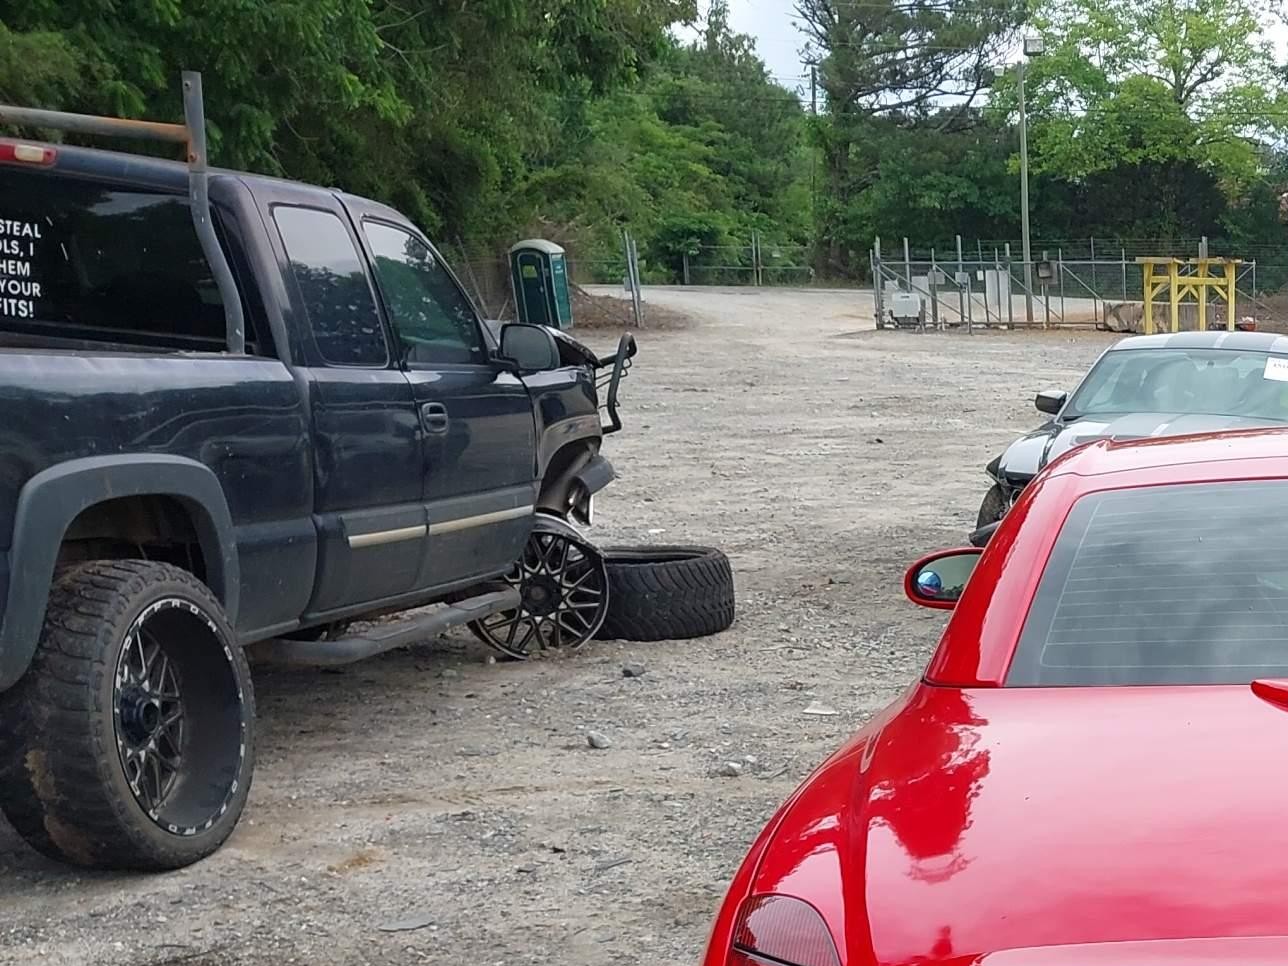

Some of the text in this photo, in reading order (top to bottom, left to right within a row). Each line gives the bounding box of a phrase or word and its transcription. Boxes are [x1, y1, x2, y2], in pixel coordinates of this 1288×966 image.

[0, 218, 42, 240] STEAL
[0, 239, 34, 258] LS, I
[0, 279, 42, 298] YOUR
[0, 297, 34, 318] ITS!
